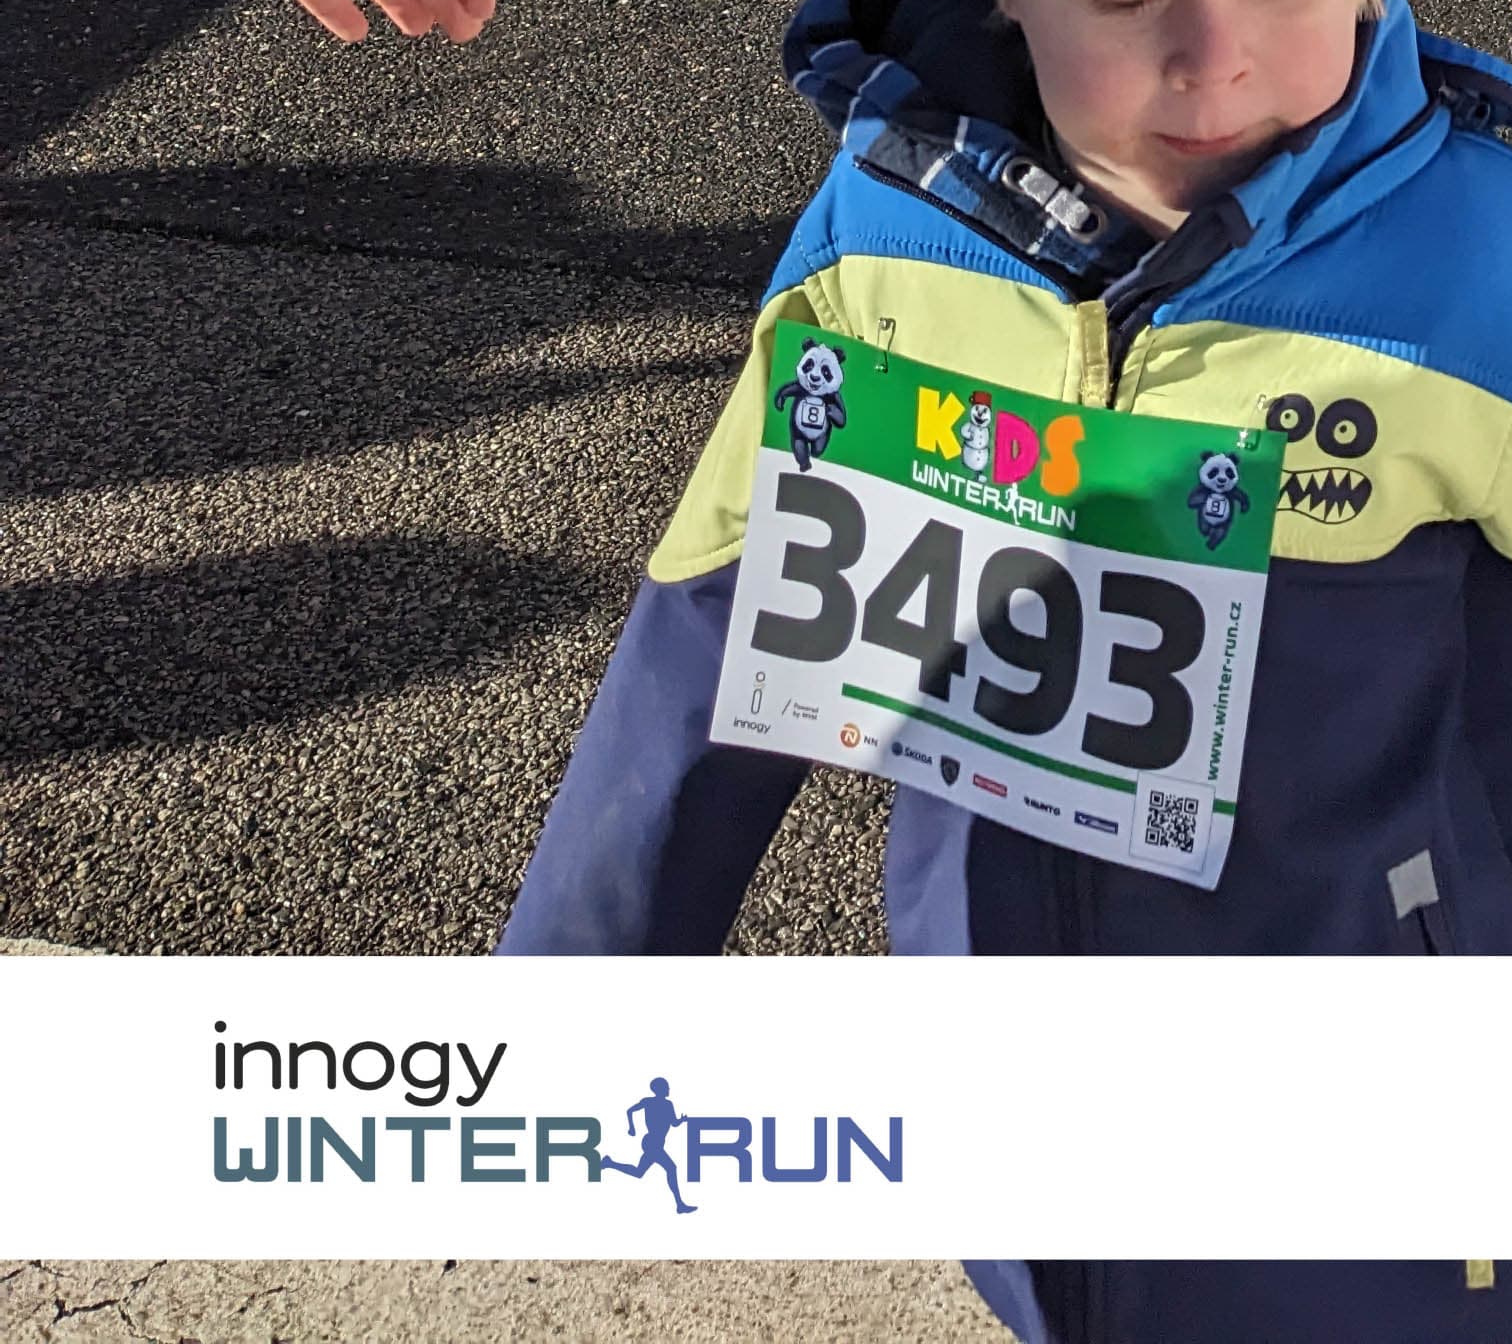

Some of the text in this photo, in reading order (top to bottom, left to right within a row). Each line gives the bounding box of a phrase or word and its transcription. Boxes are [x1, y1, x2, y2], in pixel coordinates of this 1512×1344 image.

[912, 459, 1076, 532] WINTER RUN
[751, 471, 1206, 772] 3493
[733, 716, 771, 734] innogy
[1207, 601, 1242, 781] www.winter-run.cz
